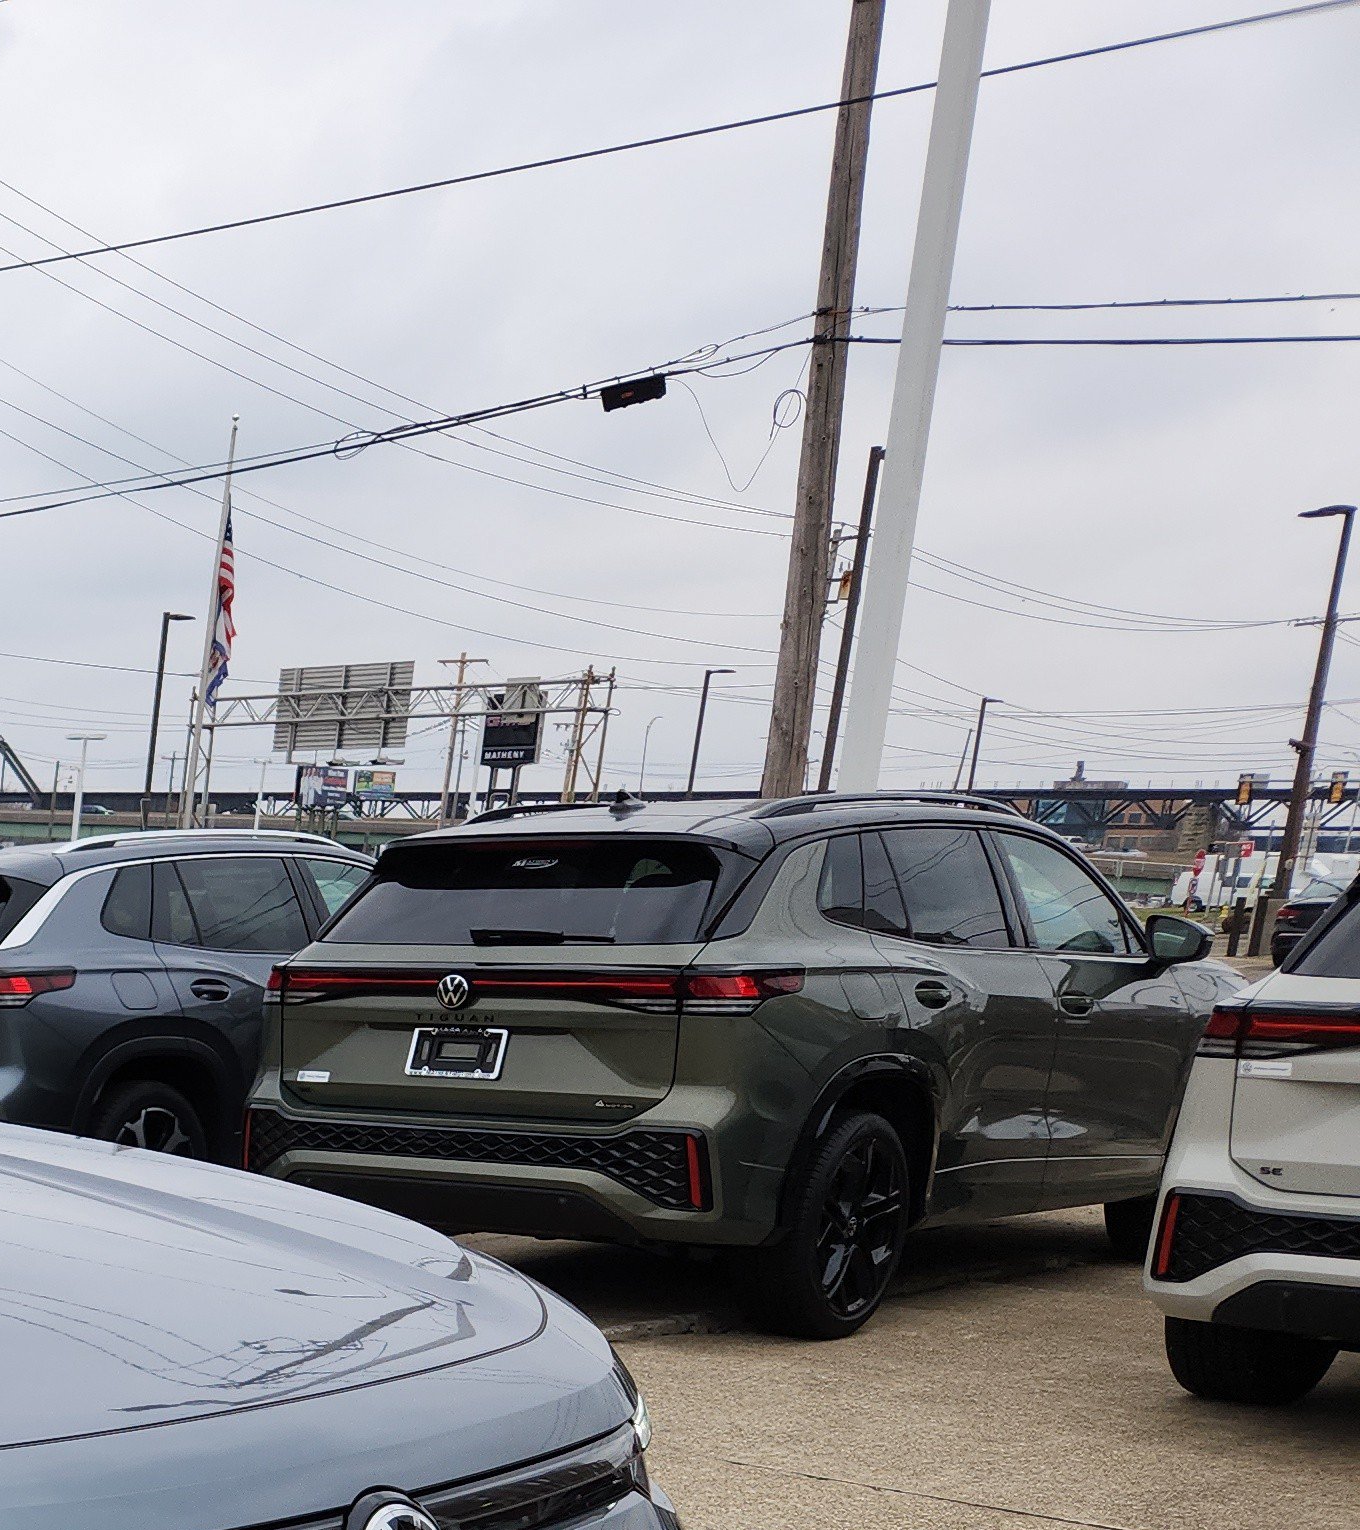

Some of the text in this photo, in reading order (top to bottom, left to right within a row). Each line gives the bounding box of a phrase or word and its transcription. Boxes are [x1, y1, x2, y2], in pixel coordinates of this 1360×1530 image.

[483, 750, 525, 760] MATHENY
[437, 975, 468, 1008] VW
[416, 1013, 495, 1023] TIGUAN
